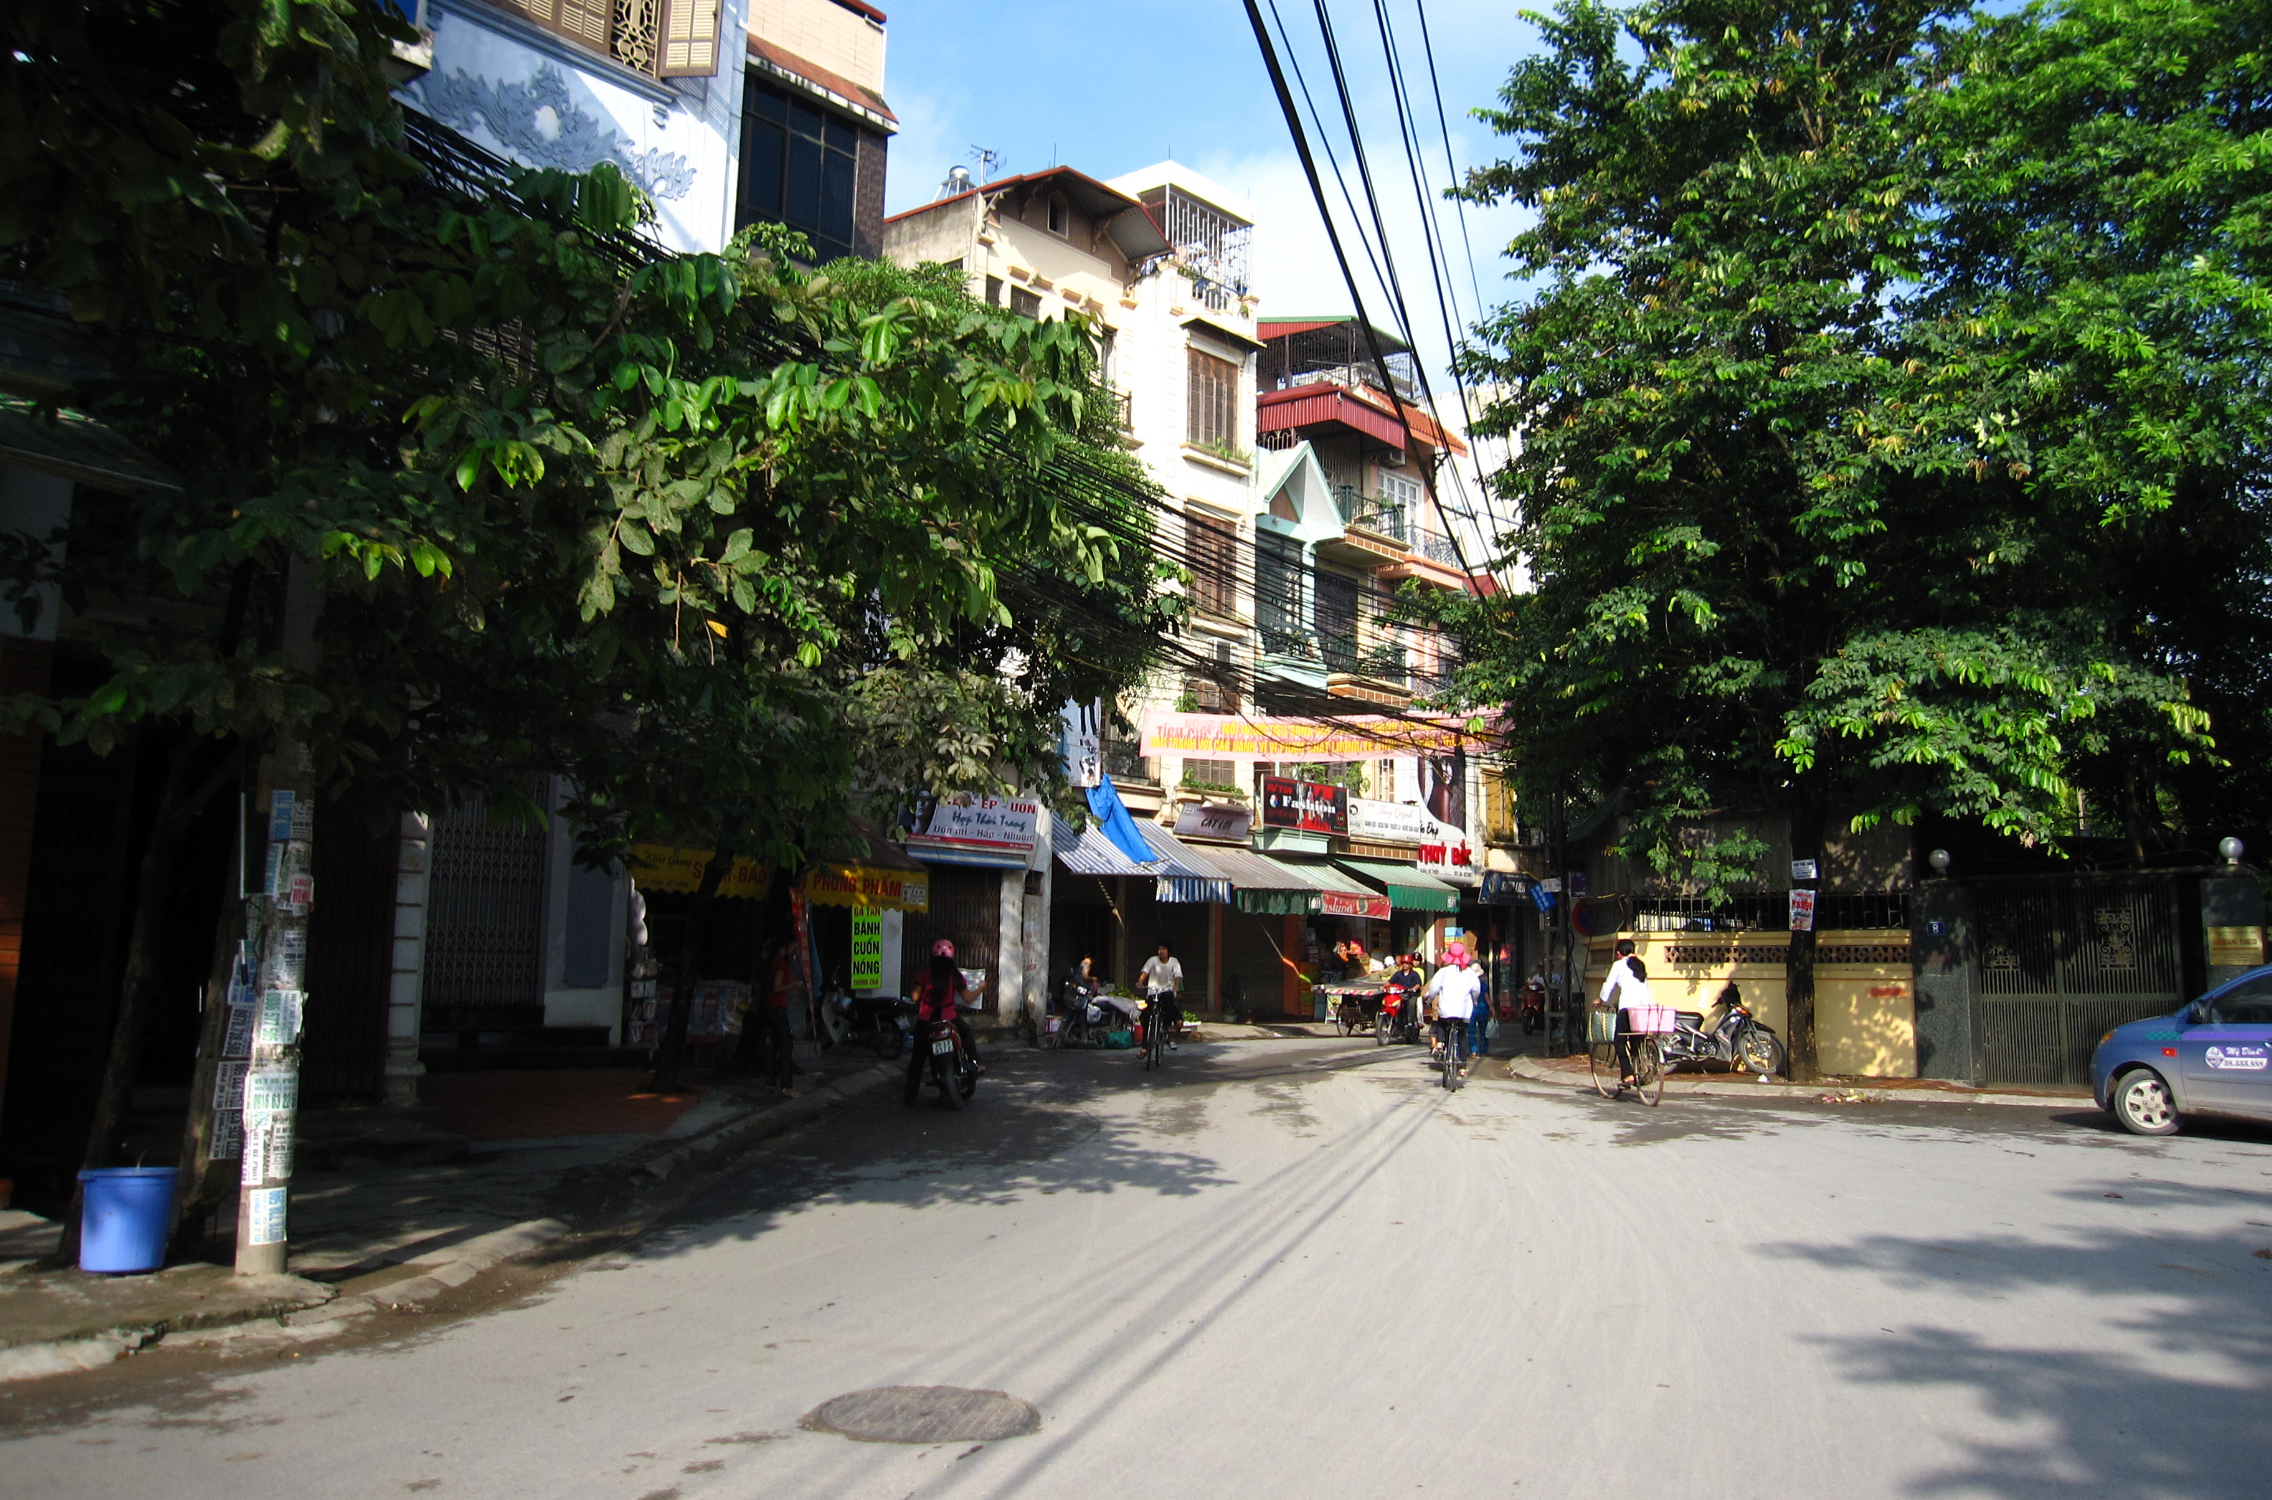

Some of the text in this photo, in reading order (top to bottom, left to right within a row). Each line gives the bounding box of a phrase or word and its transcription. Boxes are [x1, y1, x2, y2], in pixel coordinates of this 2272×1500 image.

[1282, 794, 1337, 814] Fashion
[862, 873, 902, 897] PHẨM
[854, 919, 880, 935] BÁNH
[1932, 923, 1939, 934] 8
[853, 937, 879, 955] CUỐN
[853, 958, 880, 975] NÓNG
